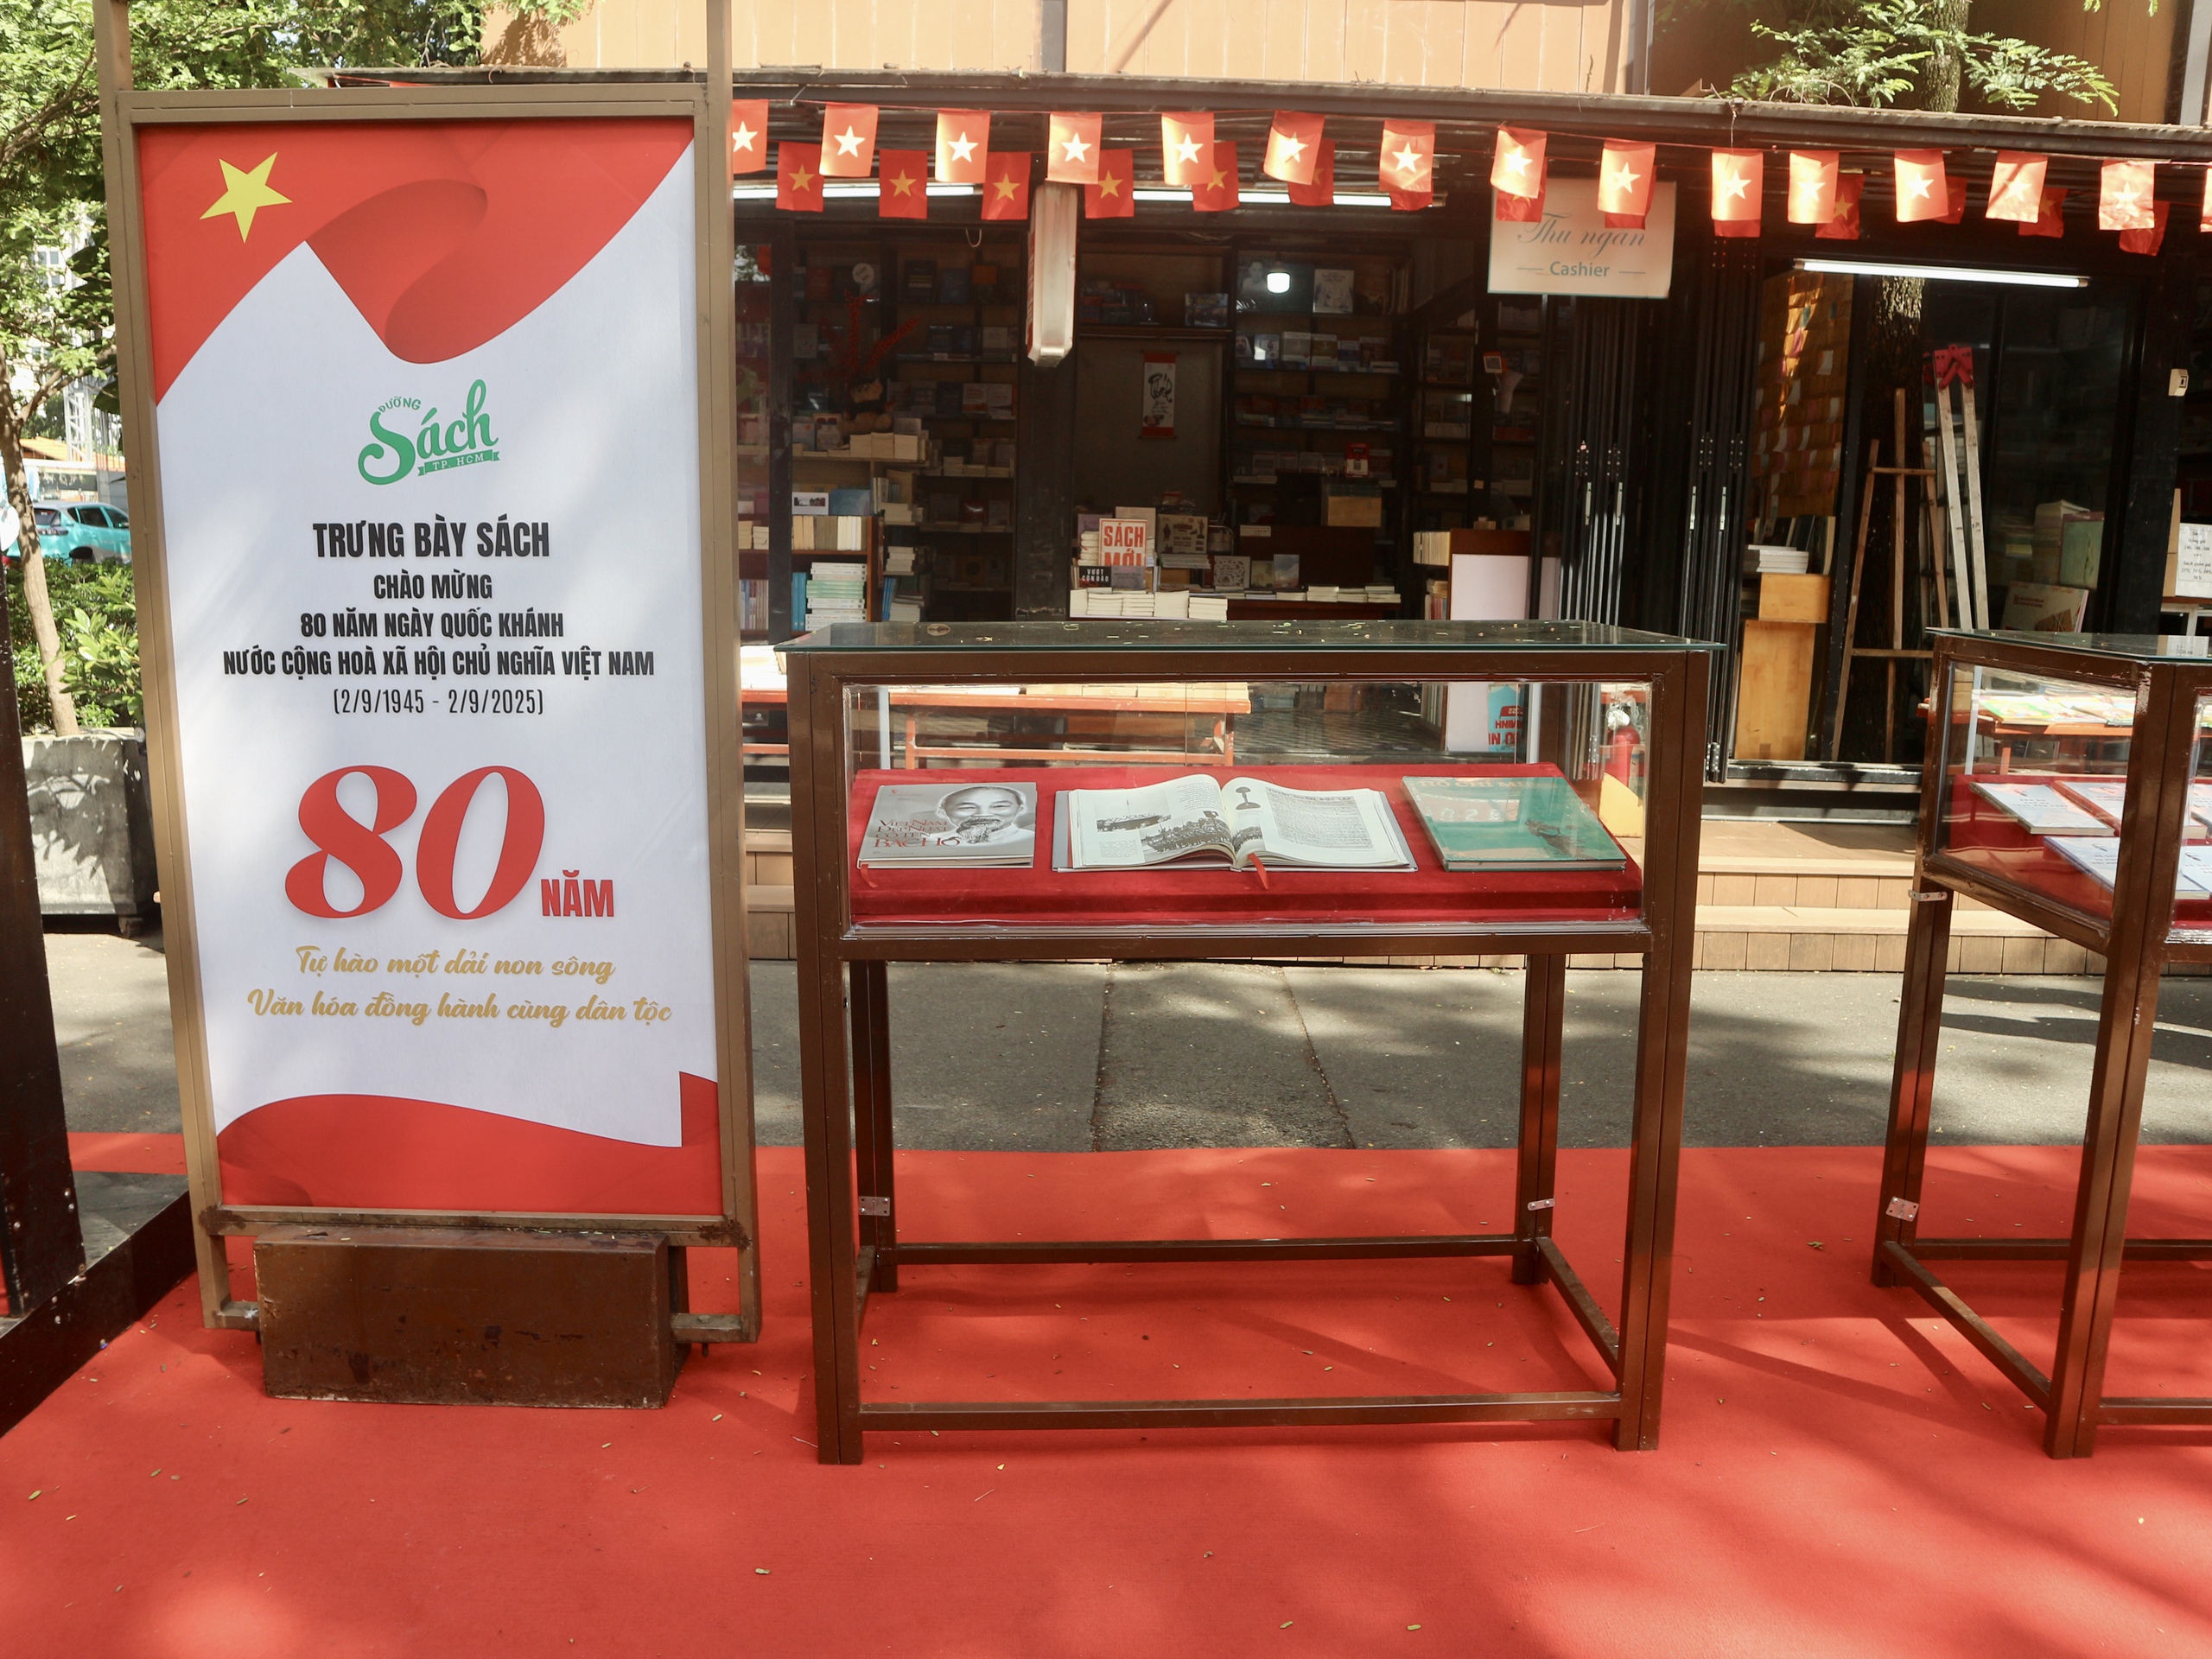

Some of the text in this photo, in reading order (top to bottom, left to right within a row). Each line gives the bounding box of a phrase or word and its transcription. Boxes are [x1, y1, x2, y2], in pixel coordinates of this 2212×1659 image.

[1517, 213, 1573, 245] Thu
[1549, 261, 1611, 277] Cashier
[358, 378, 499, 486] Sách
[432, 453, 485, 471] TP. HCM
[313, 513, 550, 557] TRƯNG BÀY SÁCH
[1103, 522, 1144, 548] SÁCH
[1103, 548, 1142, 566] MỚI
[373, 569, 493, 600] CHÀO MỪNG
[301, 607, 563, 639] 80 NĂM NGÀY QUỐC KHÁNH
[223, 643, 654, 680] NƯỚC CỘNG HOÀ XÃ HỘI CHỦ NGHĨA VIỆT NAM
[334, 689, 424, 715] (2/9/1945
[448, 689, 543, 715] 2/9/2025)
[284, 765, 614, 920] 80 NĂM
[296, 945, 616, 985] Tự hào một dải non sông
[247, 988, 672, 1028] Văn hóa đồng hành cùng dân tộc
